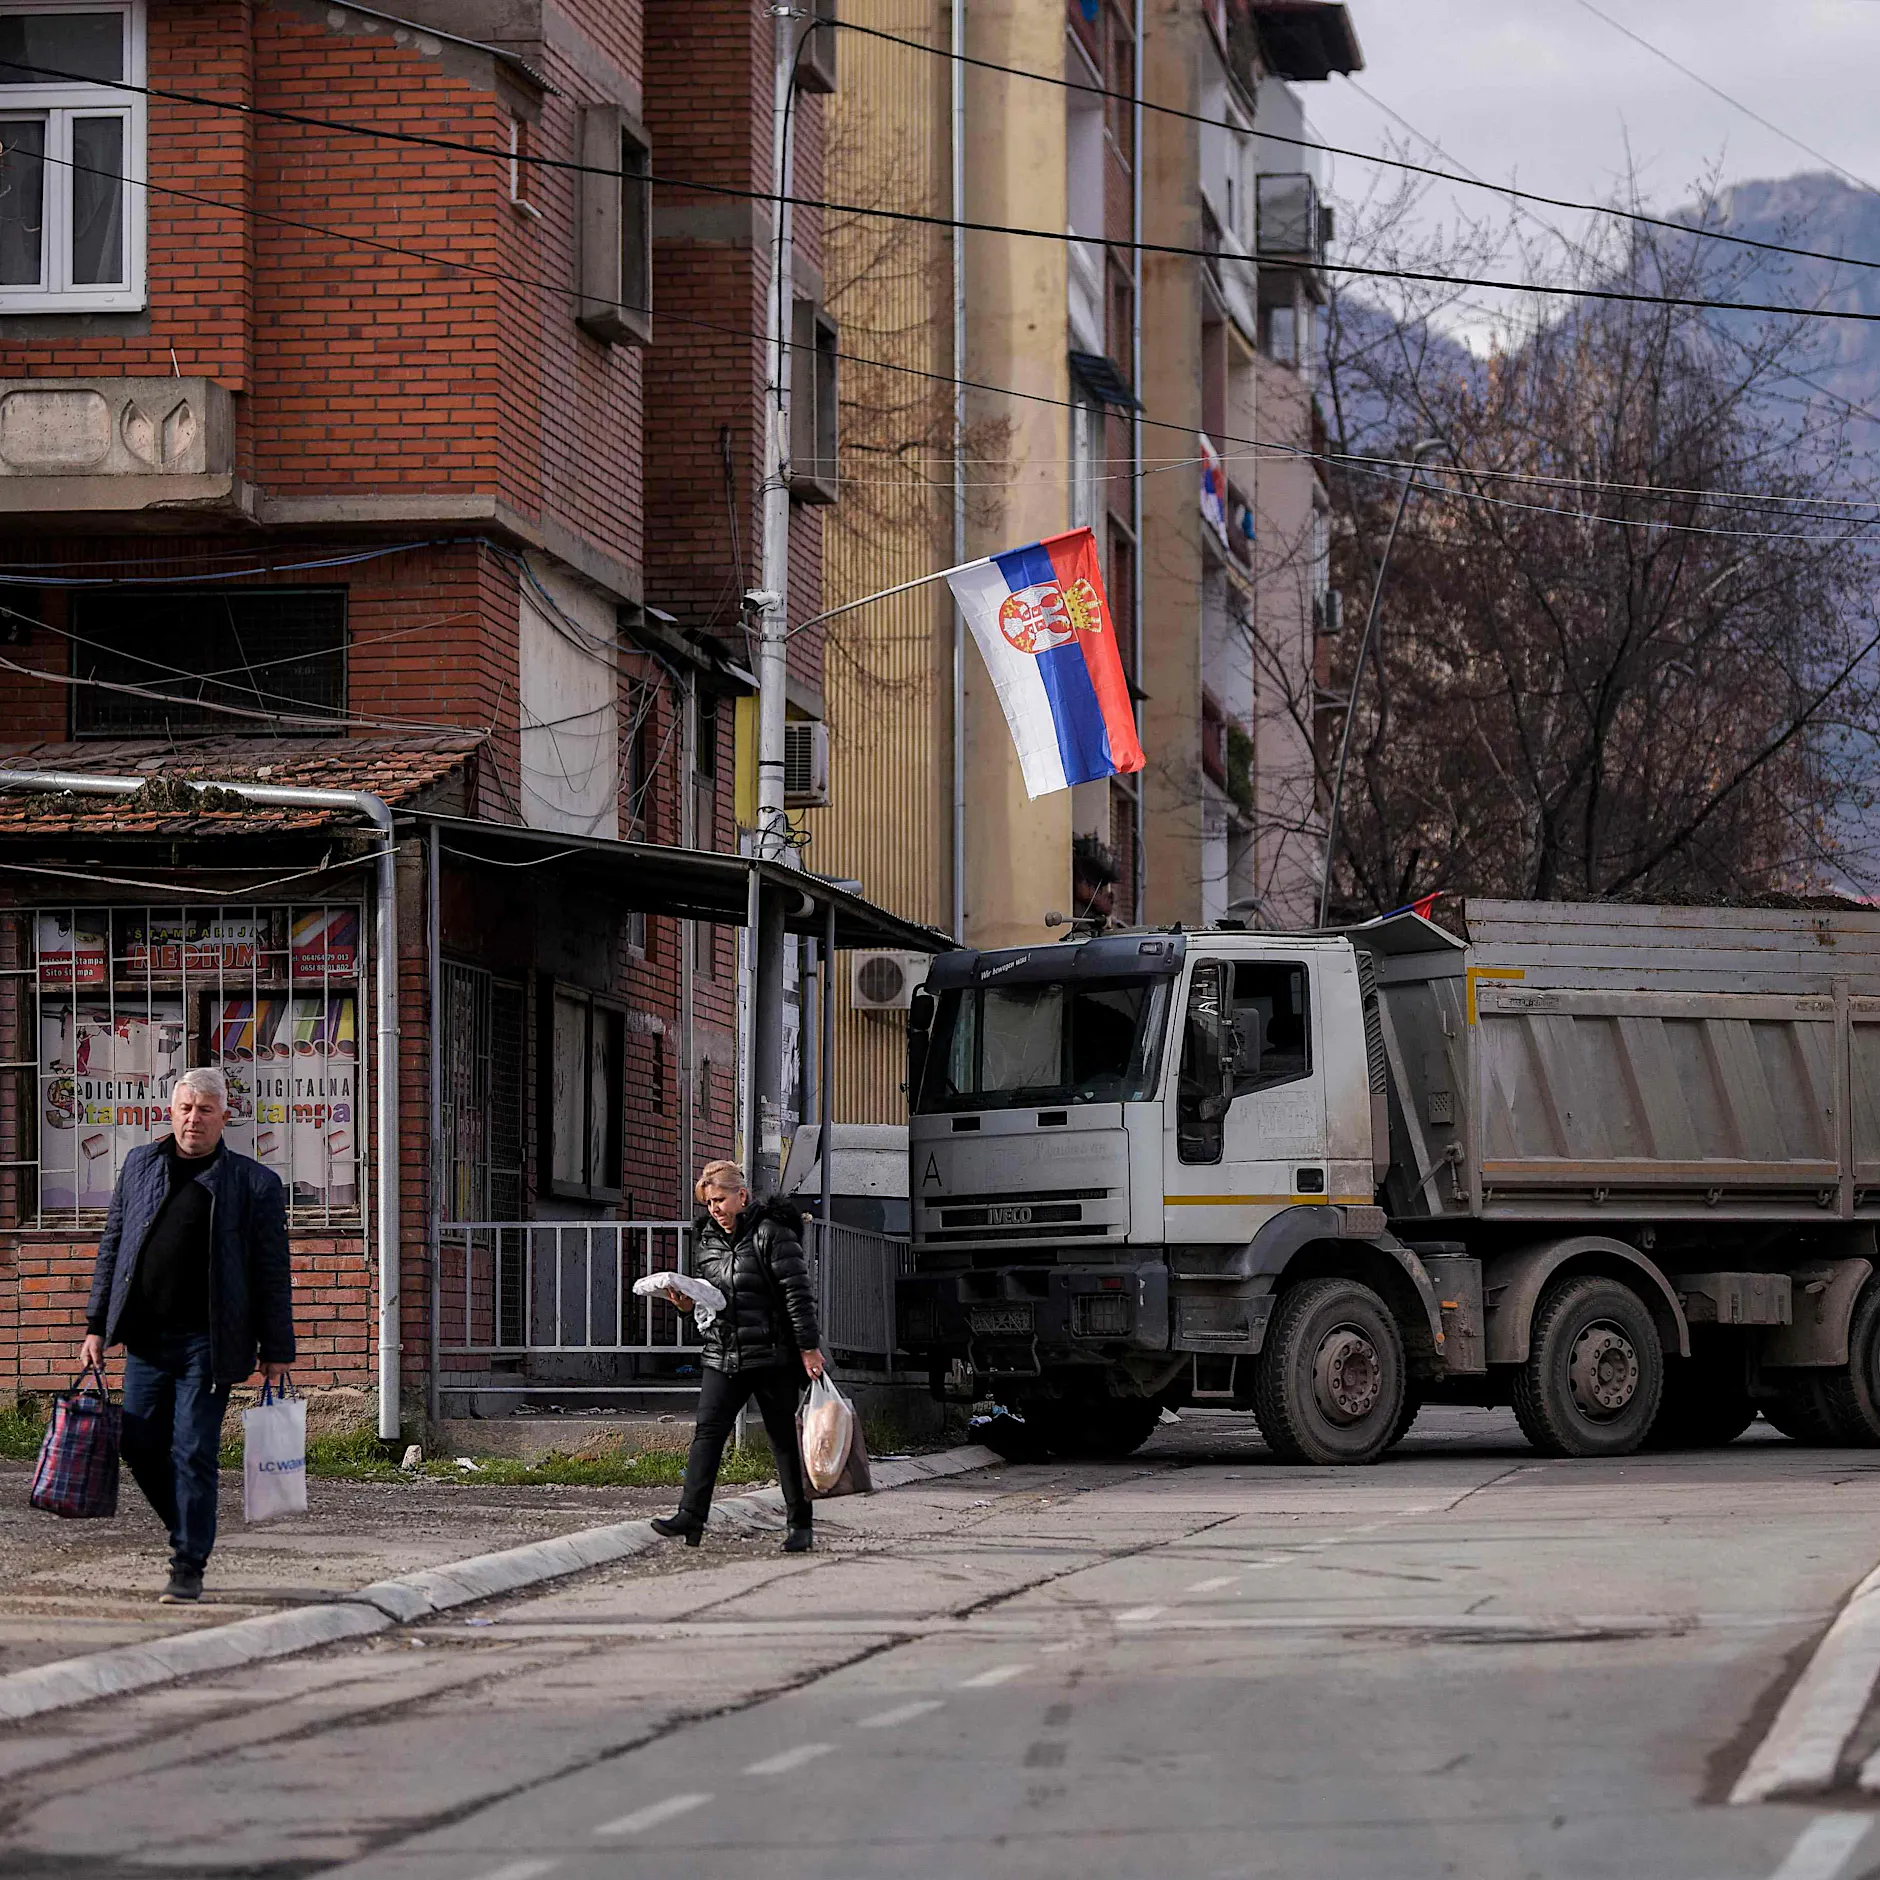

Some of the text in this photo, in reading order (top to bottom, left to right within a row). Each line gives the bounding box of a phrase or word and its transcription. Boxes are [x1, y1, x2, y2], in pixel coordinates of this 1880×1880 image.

[133, 944, 261, 968] MEDIUM
[85, 1080, 177, 1100] DIGITALN
[257, 1079, 350, 1098] DIGITALNA
[922, 1151, 943, 1188] A
[987, 1207, 1032, 1225] IVECO
